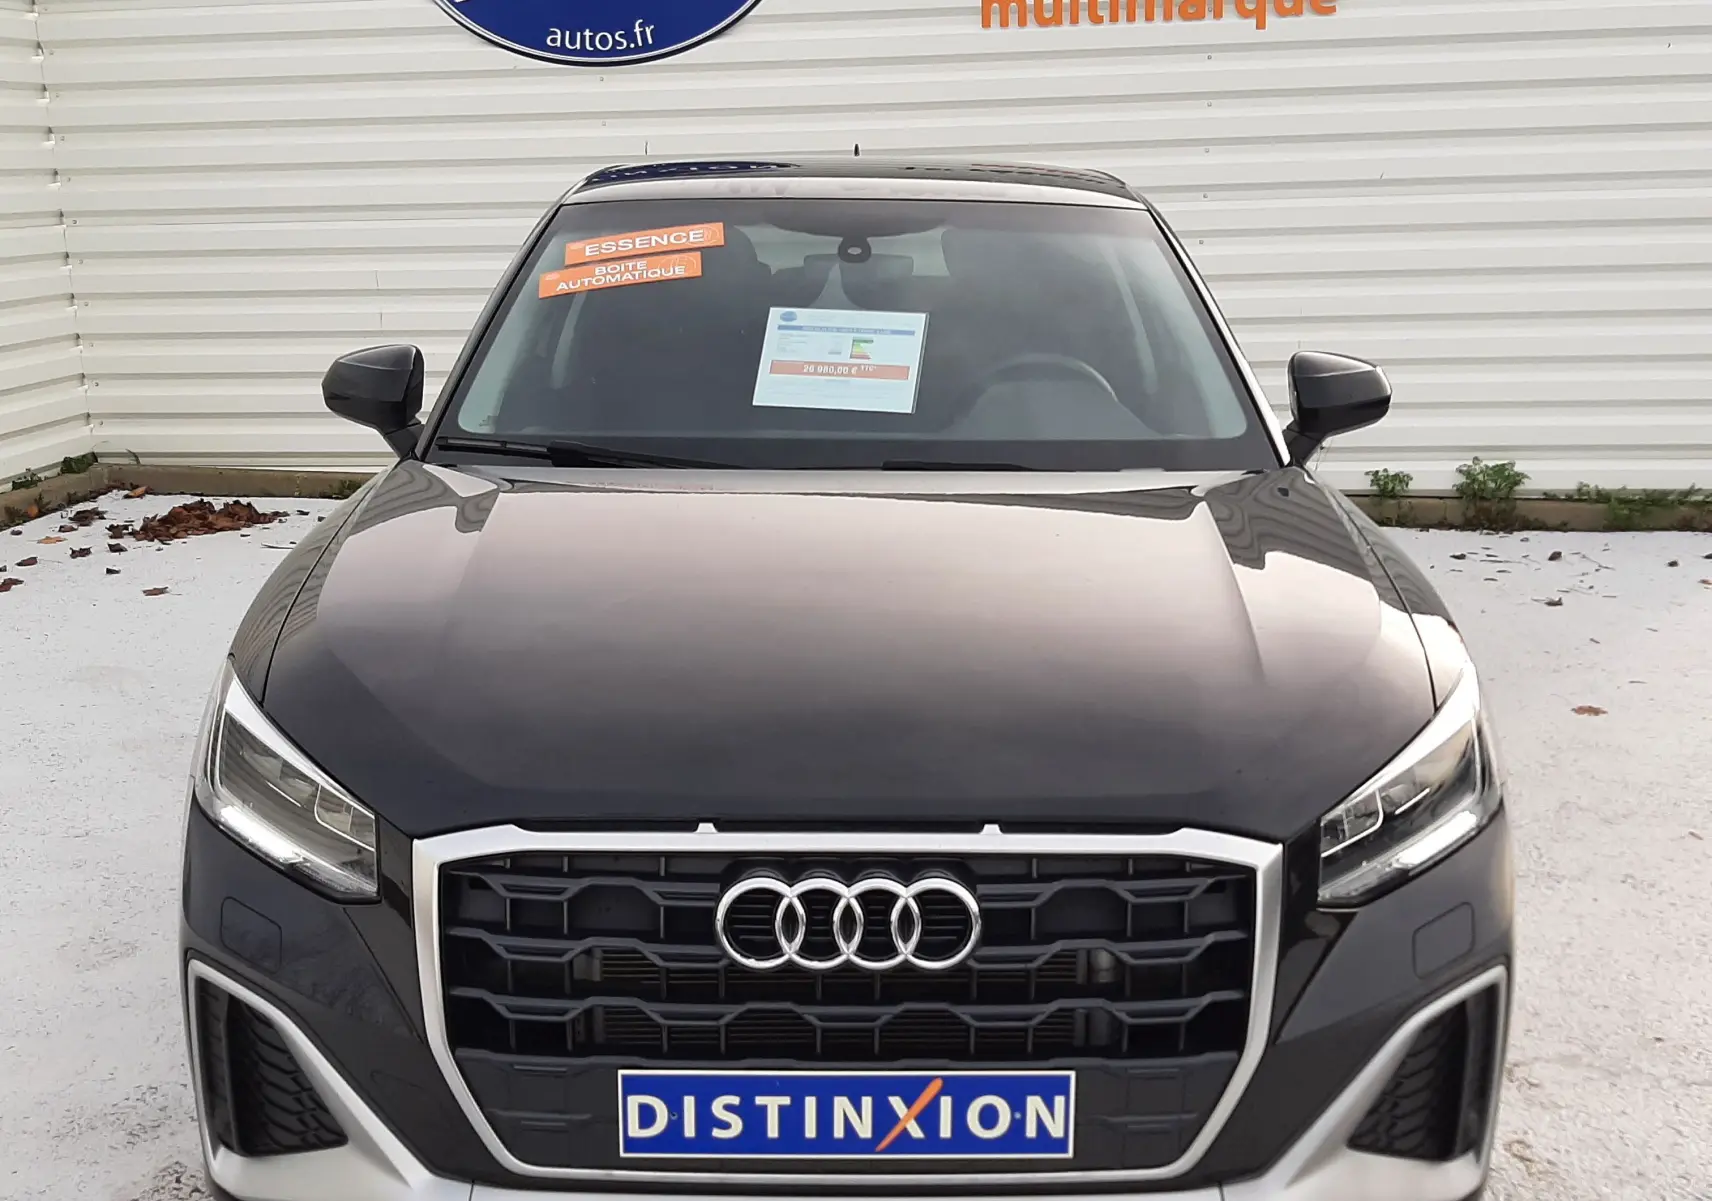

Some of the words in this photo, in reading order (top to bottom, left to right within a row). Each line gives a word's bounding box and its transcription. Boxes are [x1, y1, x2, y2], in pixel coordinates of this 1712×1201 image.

[546, 19, 655, 51] autos.fr
[585, 229, 704, 257] ESSENCE
[556, 265, 686, 292] AUTOMATIQUE
[595, 261, 648, 276] BOITE
[626, 1077, 1066, 1152] DISTINXION
